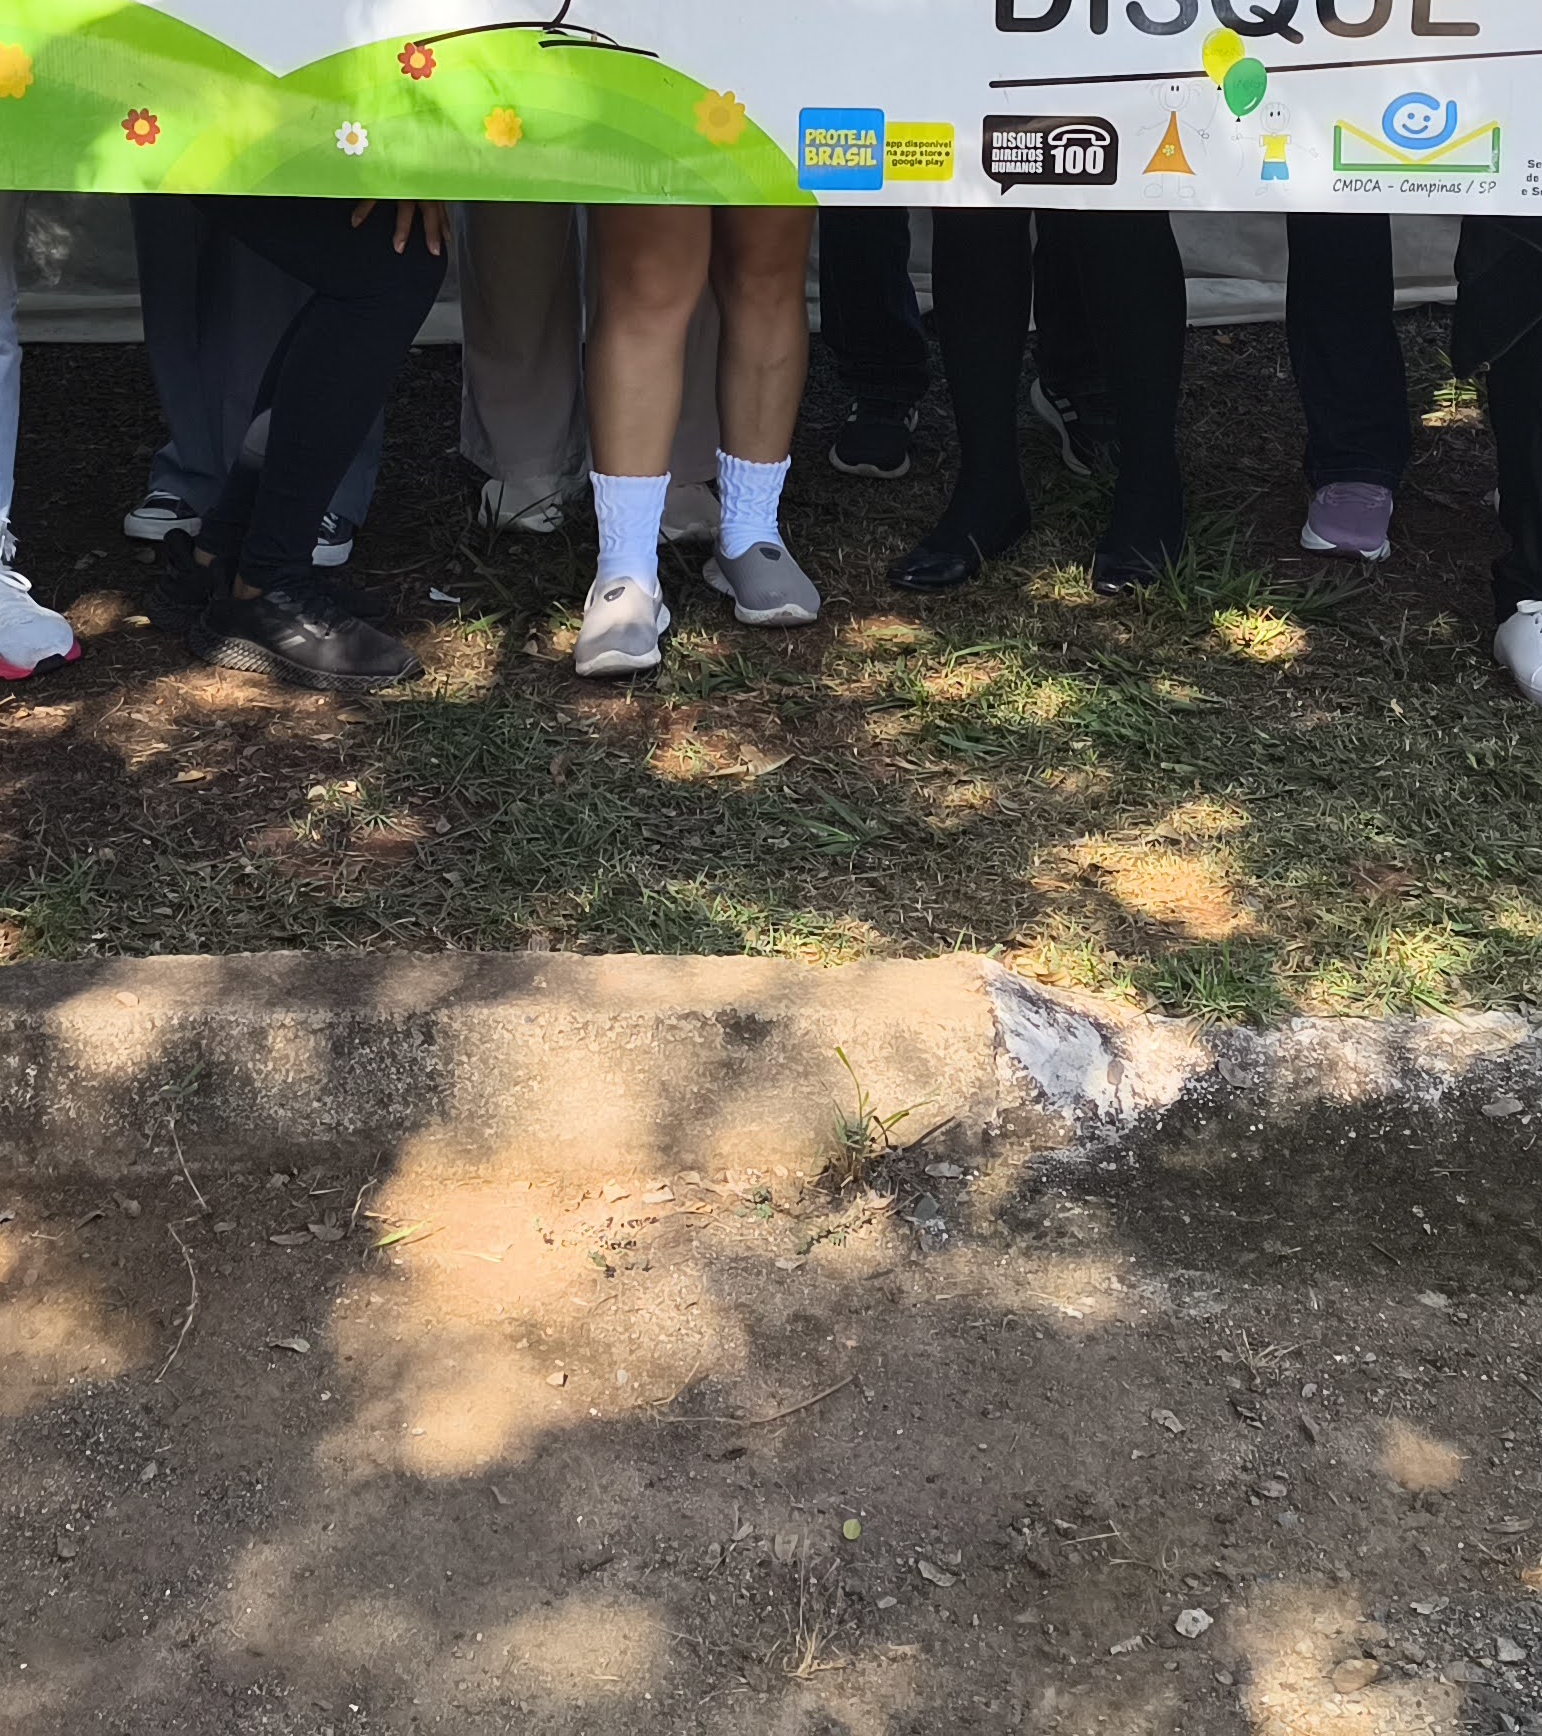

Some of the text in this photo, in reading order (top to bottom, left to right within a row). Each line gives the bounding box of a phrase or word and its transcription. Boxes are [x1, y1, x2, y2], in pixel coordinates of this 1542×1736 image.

[805, 128, 878, 146] PROTEJA
[992, 132, 1044, 149] DISQUE
[804, 147, 877, 167] BRASIL
[892, 158, 944, 167] google play
[991, 148, 1044, 161] DIREITOS
[1050, 146, 1105, 174] 100
[991, 161, 1043, 174] HUMANOS
[1332, 178, 1382, 192] CMDCA
[1400, 179, 1462, 197] Campinas
[1478, 181, 1497, 194] SP
